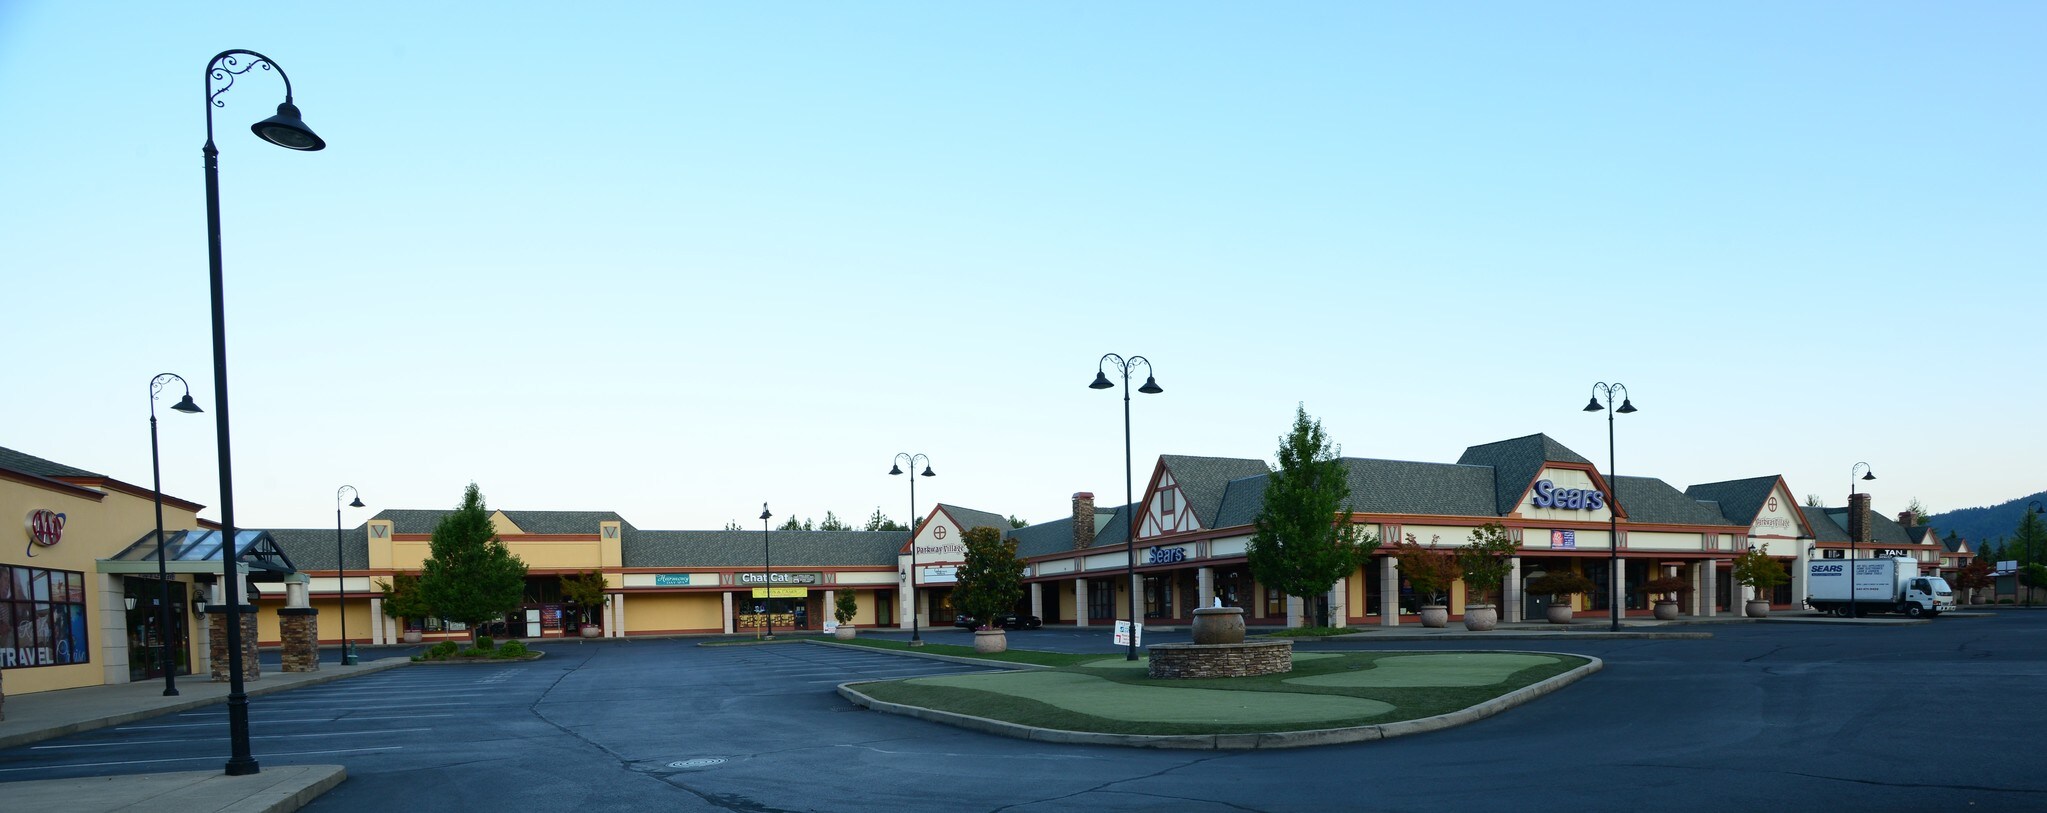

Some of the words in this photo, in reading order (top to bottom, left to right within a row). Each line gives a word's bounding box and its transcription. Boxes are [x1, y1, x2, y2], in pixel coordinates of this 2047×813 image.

[1533, 479, 1604, 510] Sears
[34, 510, 61, 545] AAA
[917, 546, 942, 555] Parkway
[943, 544, 964, 553] Village
[1149, 546, 1184, 564] Sears
[742, 573, 767, 582] Chat
[770, 573, 788, 582] Cat
[1811, 565, 1843, 573] SEARS
[0, 647, 54, 667] TRAVEL
